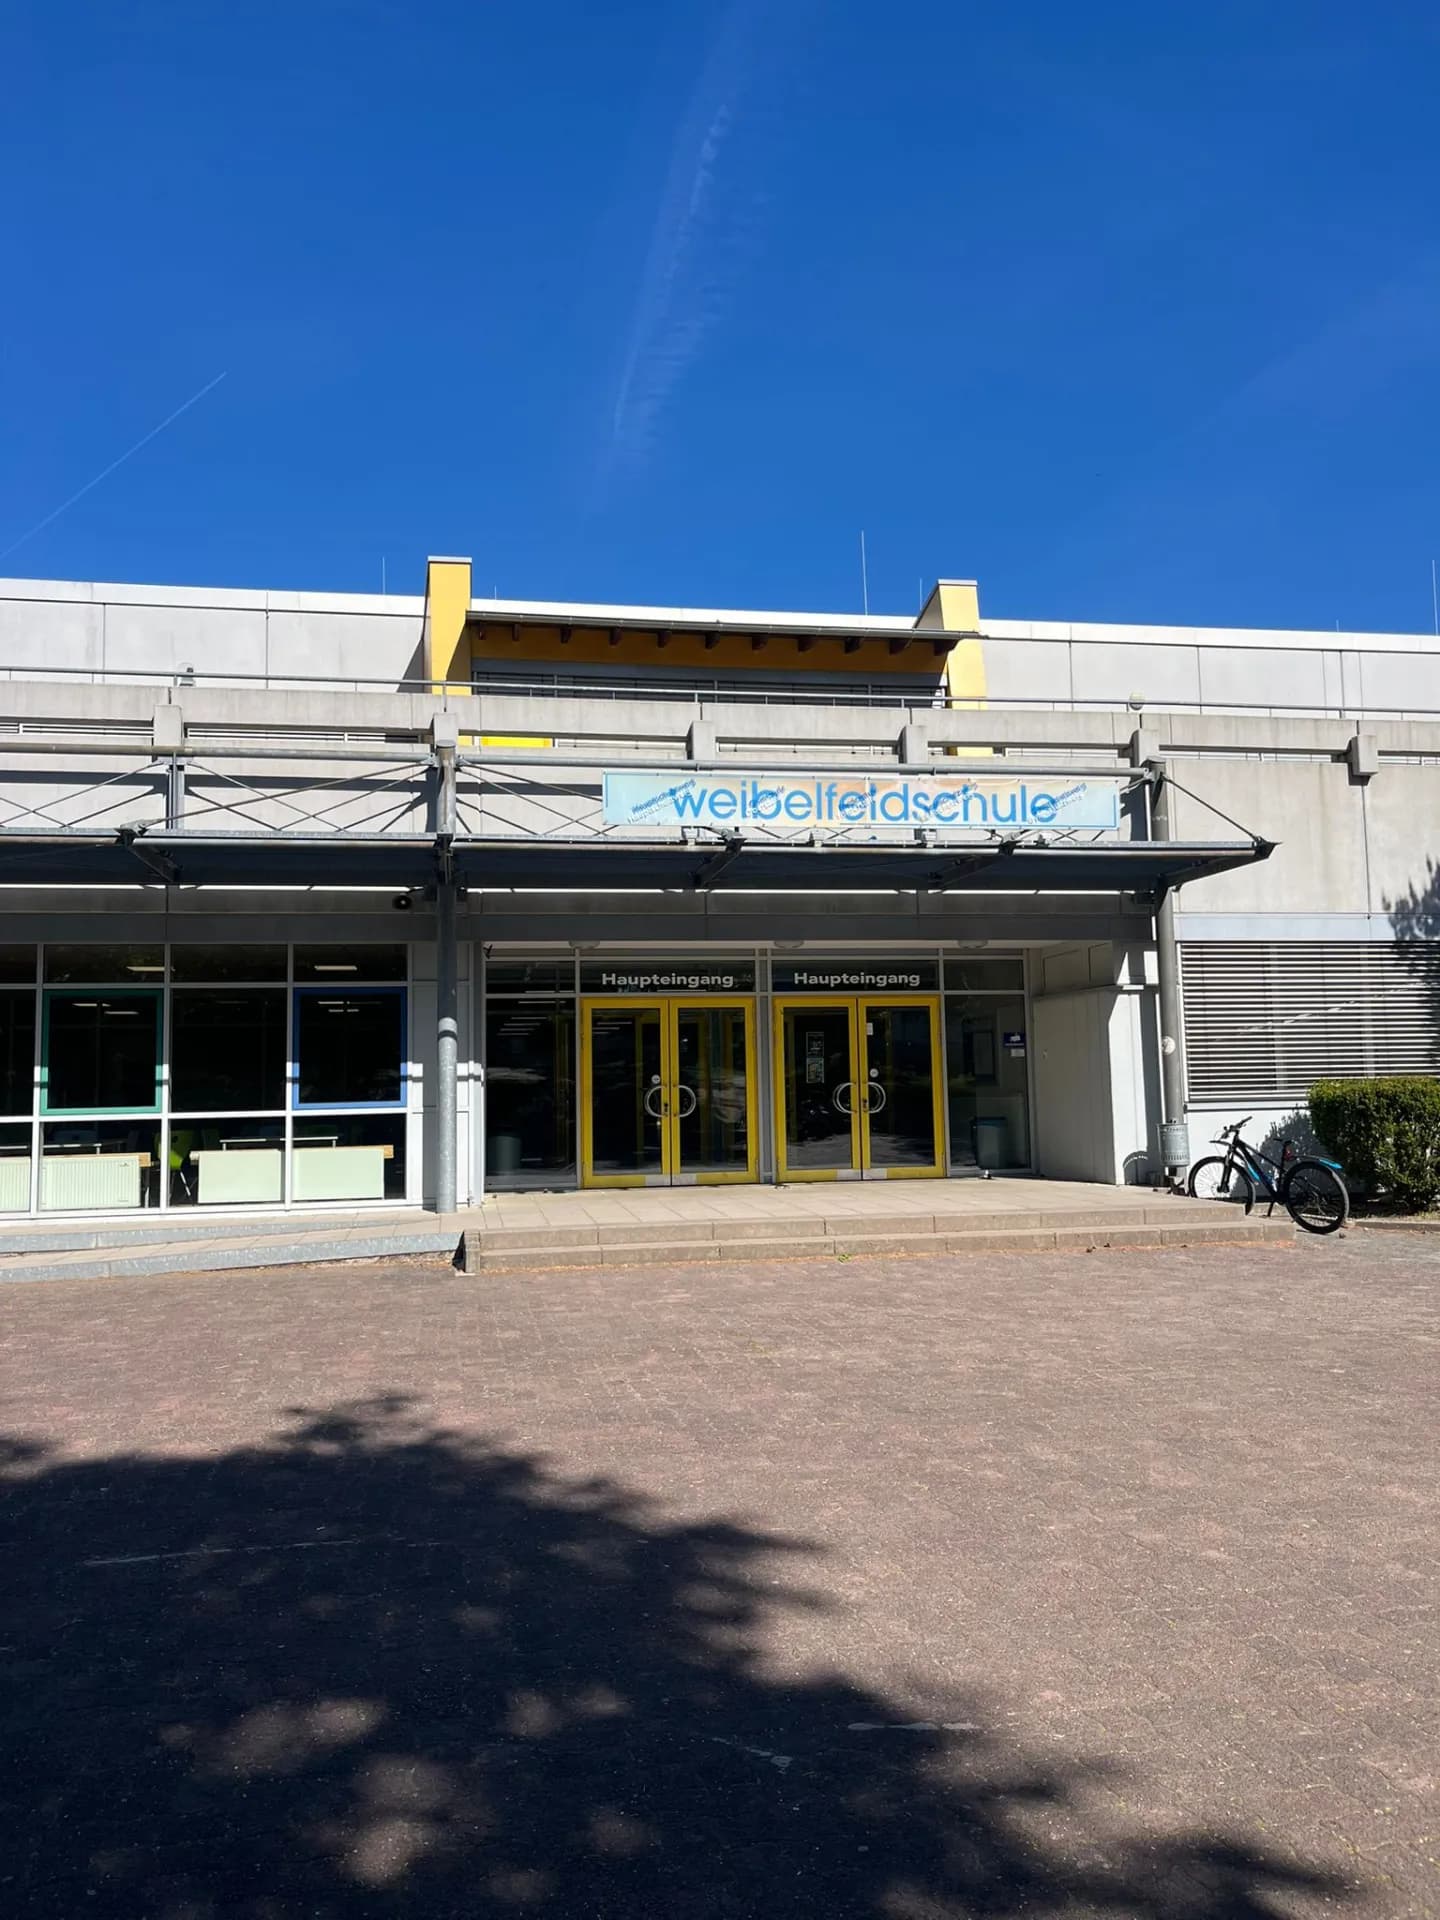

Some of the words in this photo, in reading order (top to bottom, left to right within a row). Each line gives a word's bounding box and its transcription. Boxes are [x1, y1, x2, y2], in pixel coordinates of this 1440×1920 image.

[674, 780, 1058, 823] weibelfeldschule
[601, 972, 735, 988] Haupteingang
[793, 971, 921, 987] Haupteingang
